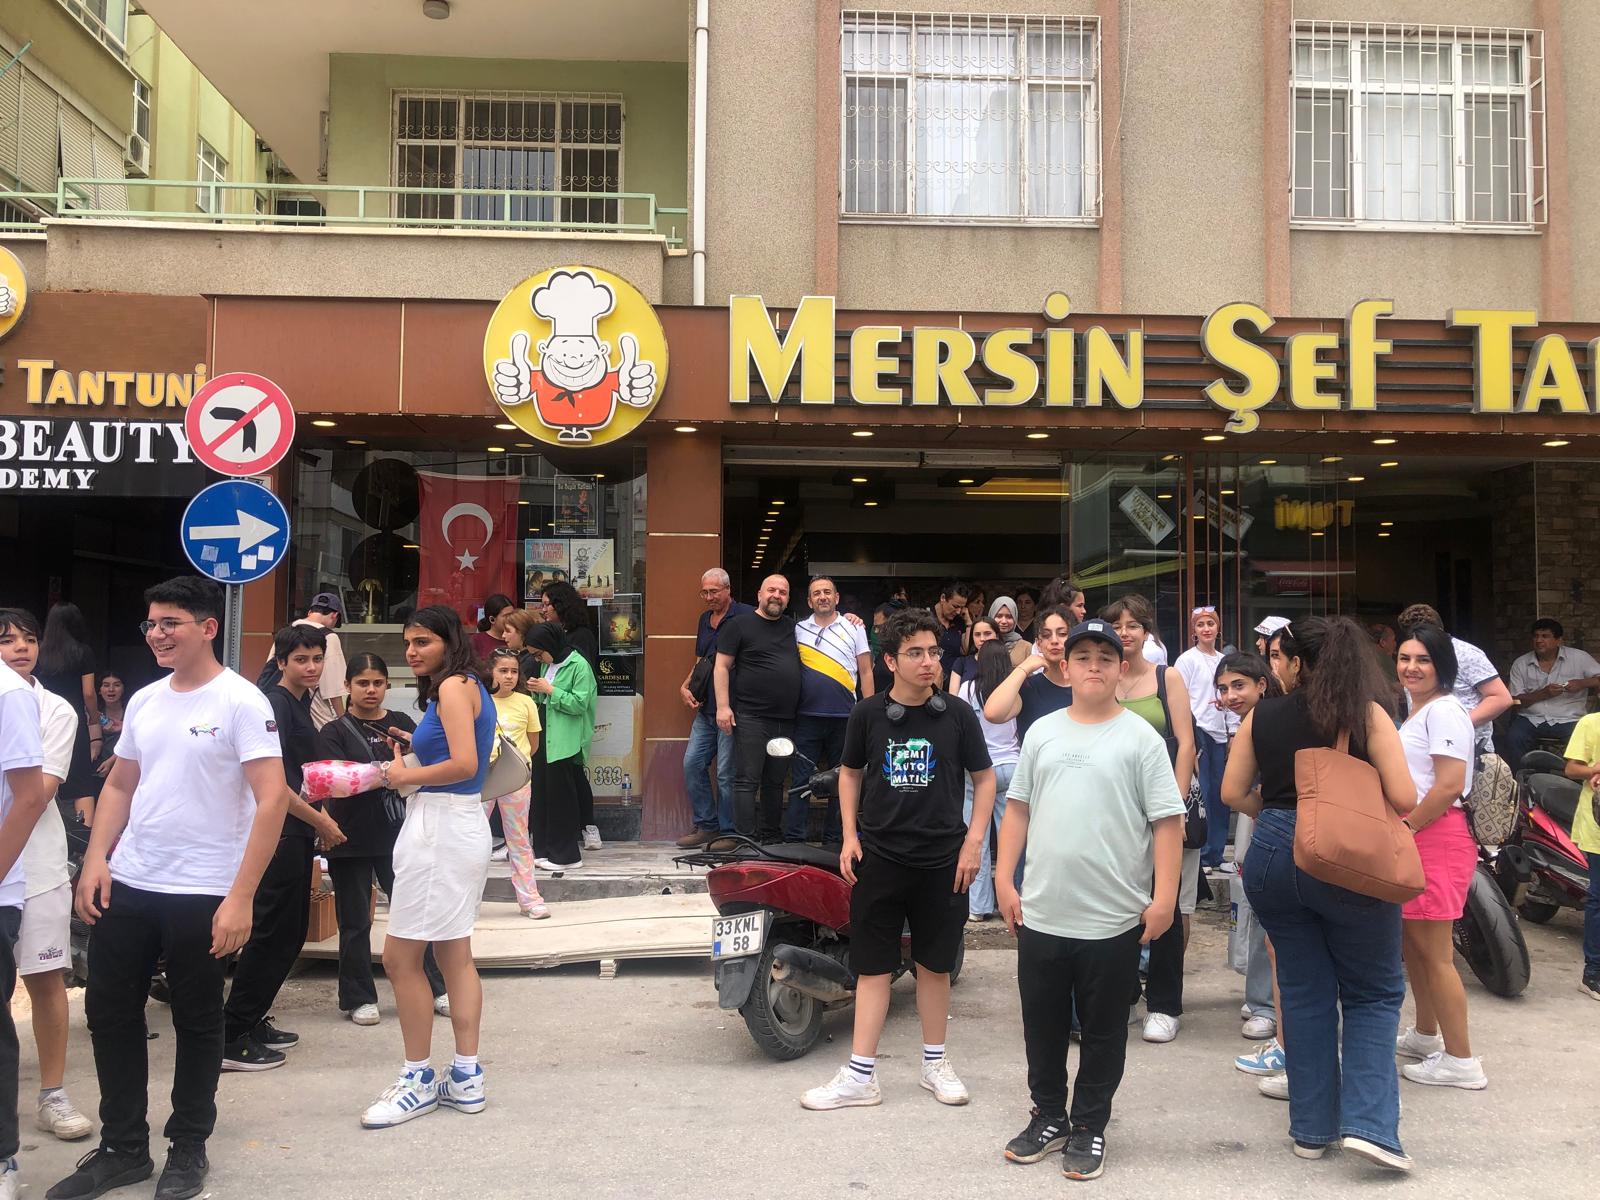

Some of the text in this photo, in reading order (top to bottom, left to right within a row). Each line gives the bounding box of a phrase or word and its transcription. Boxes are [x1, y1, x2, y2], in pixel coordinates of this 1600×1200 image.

[1201, 298, 1395, 434] ŞEF
[1445, 307, 1600, 414] TA
[896, 750, 924, 759] SEMI
[894, 762, 926, 771] AUTO
[594, 766, 623, 785] 333
[892, 774, 928, 784] MATIC
[716, 916, 759, 937] 33 KNL
[733, 935, 750, 952] 58
